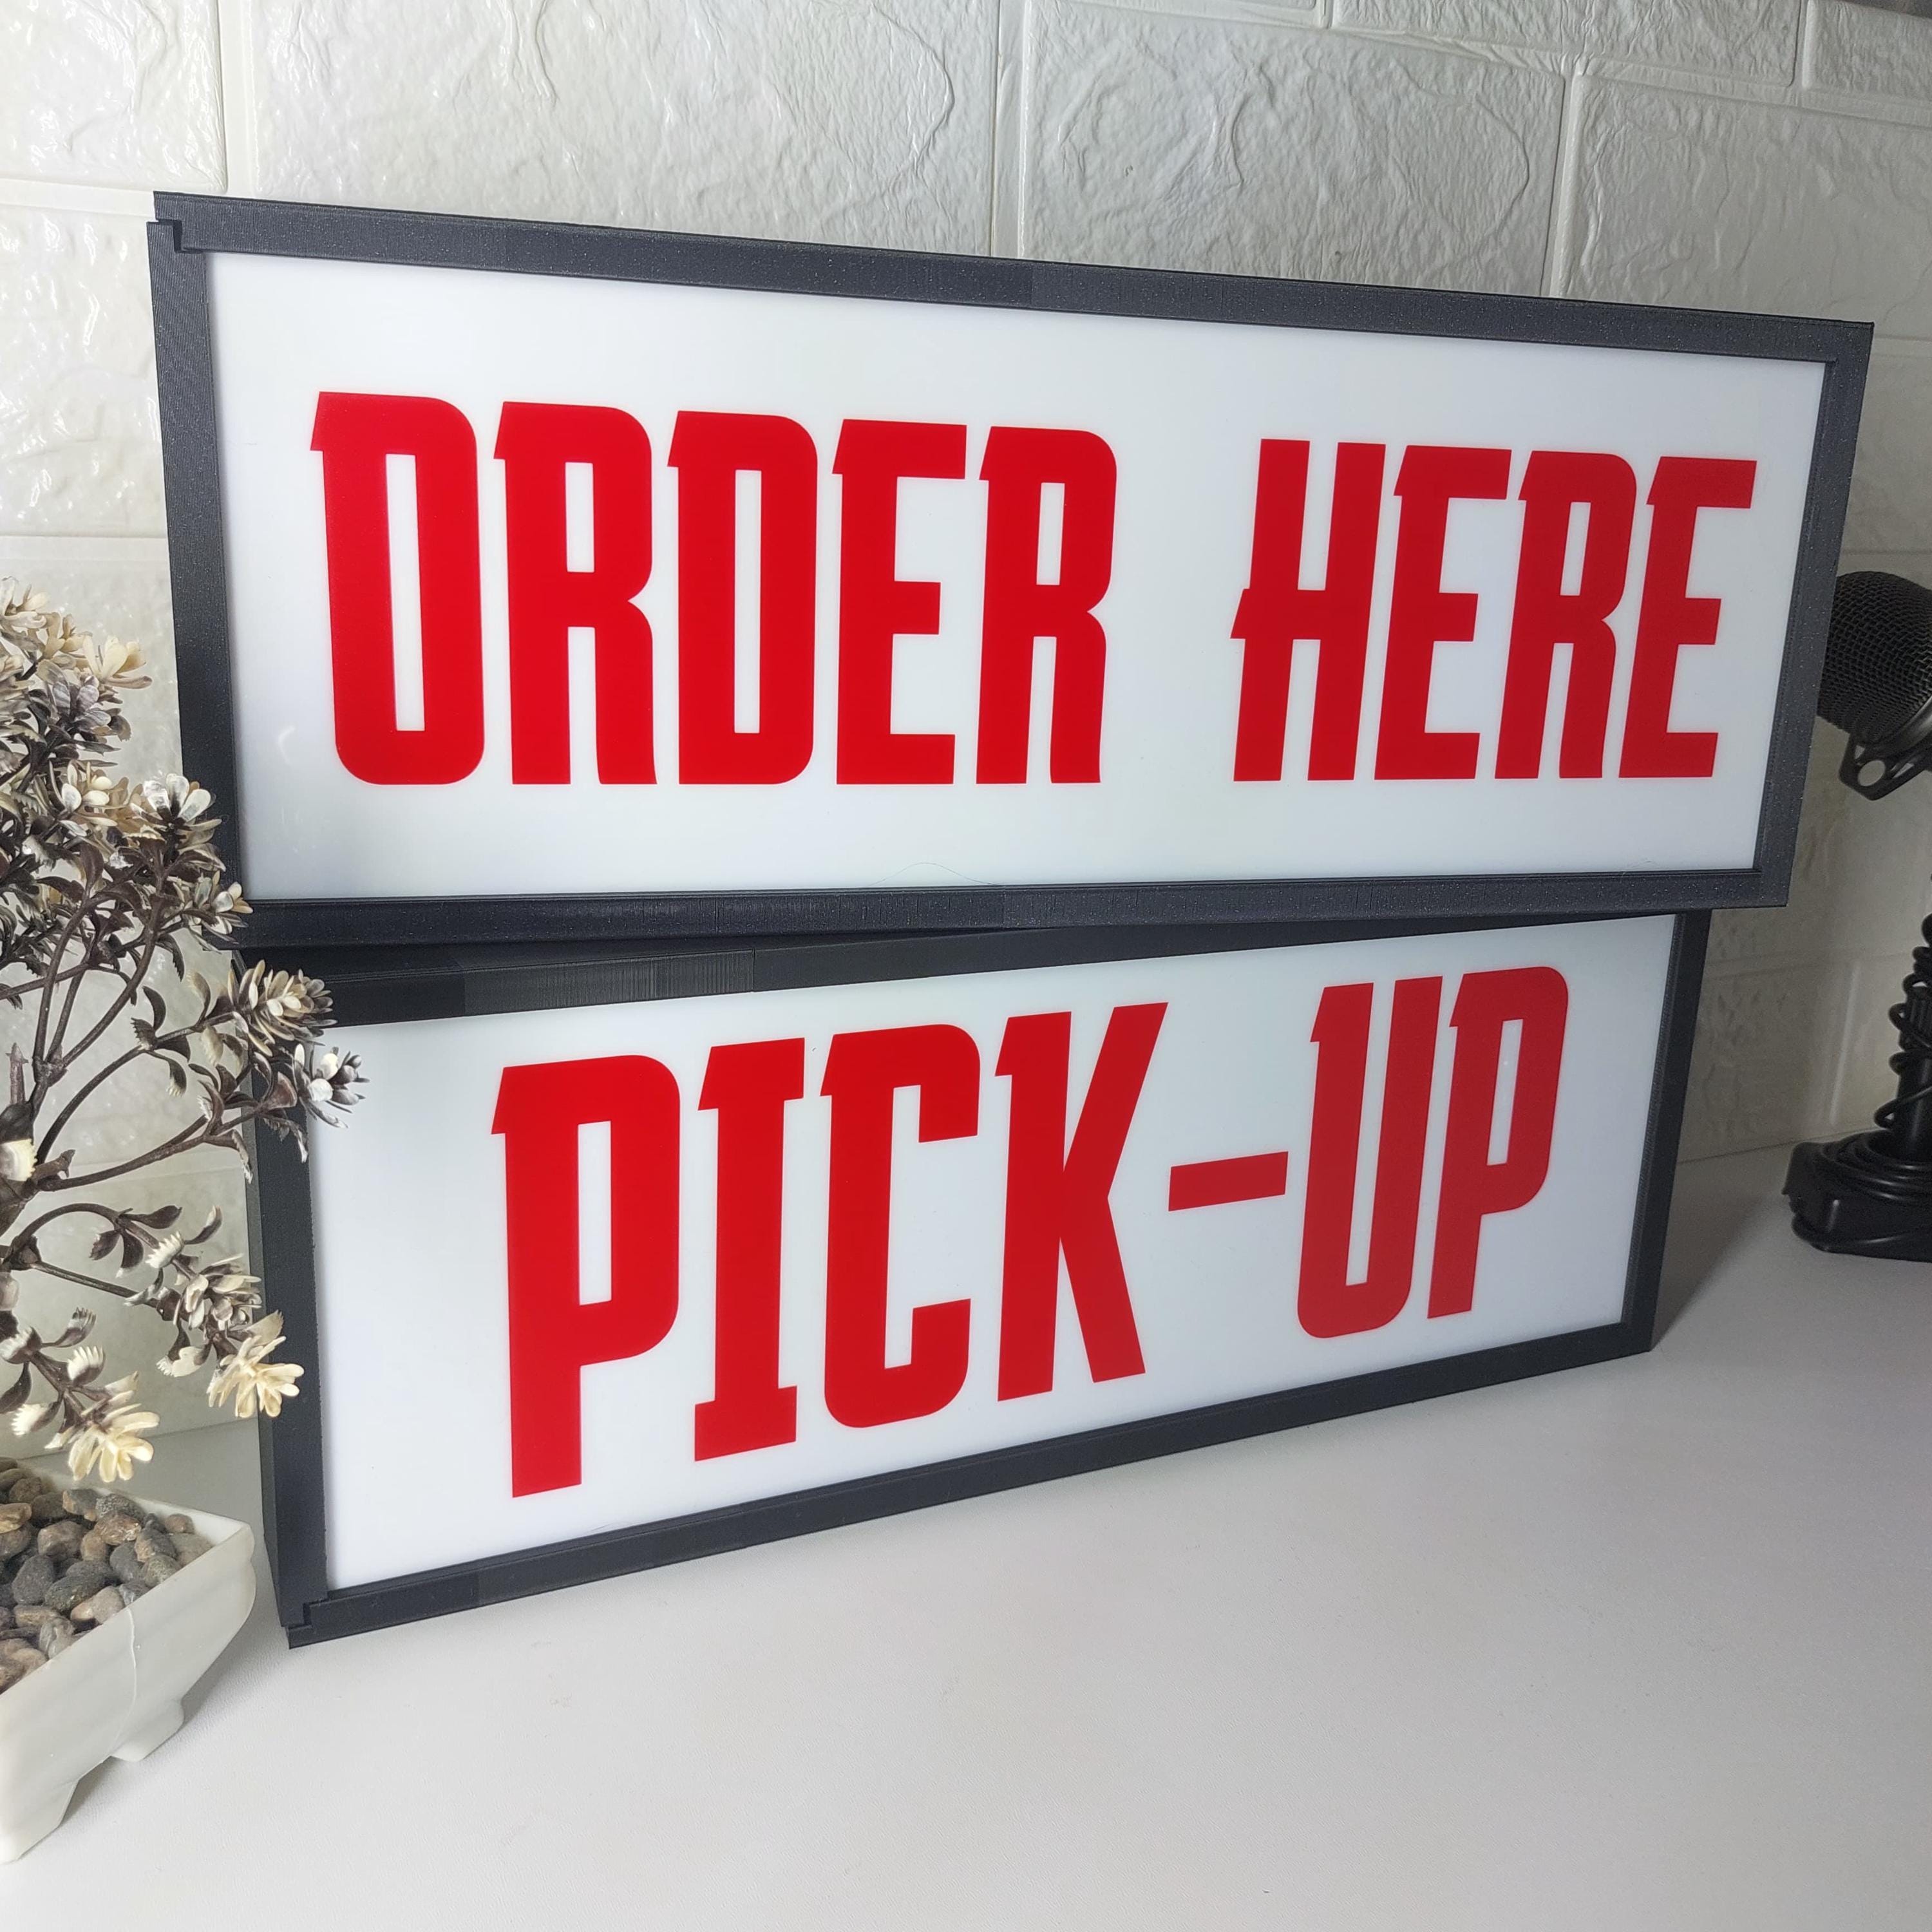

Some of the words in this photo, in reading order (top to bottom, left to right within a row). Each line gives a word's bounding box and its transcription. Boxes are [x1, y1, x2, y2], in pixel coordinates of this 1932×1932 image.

[311, 392, 1117, 785] ORDER
[1231, 439, 1757, 781] HERE
[492, 967, 1568, 1497] PICK-UP
